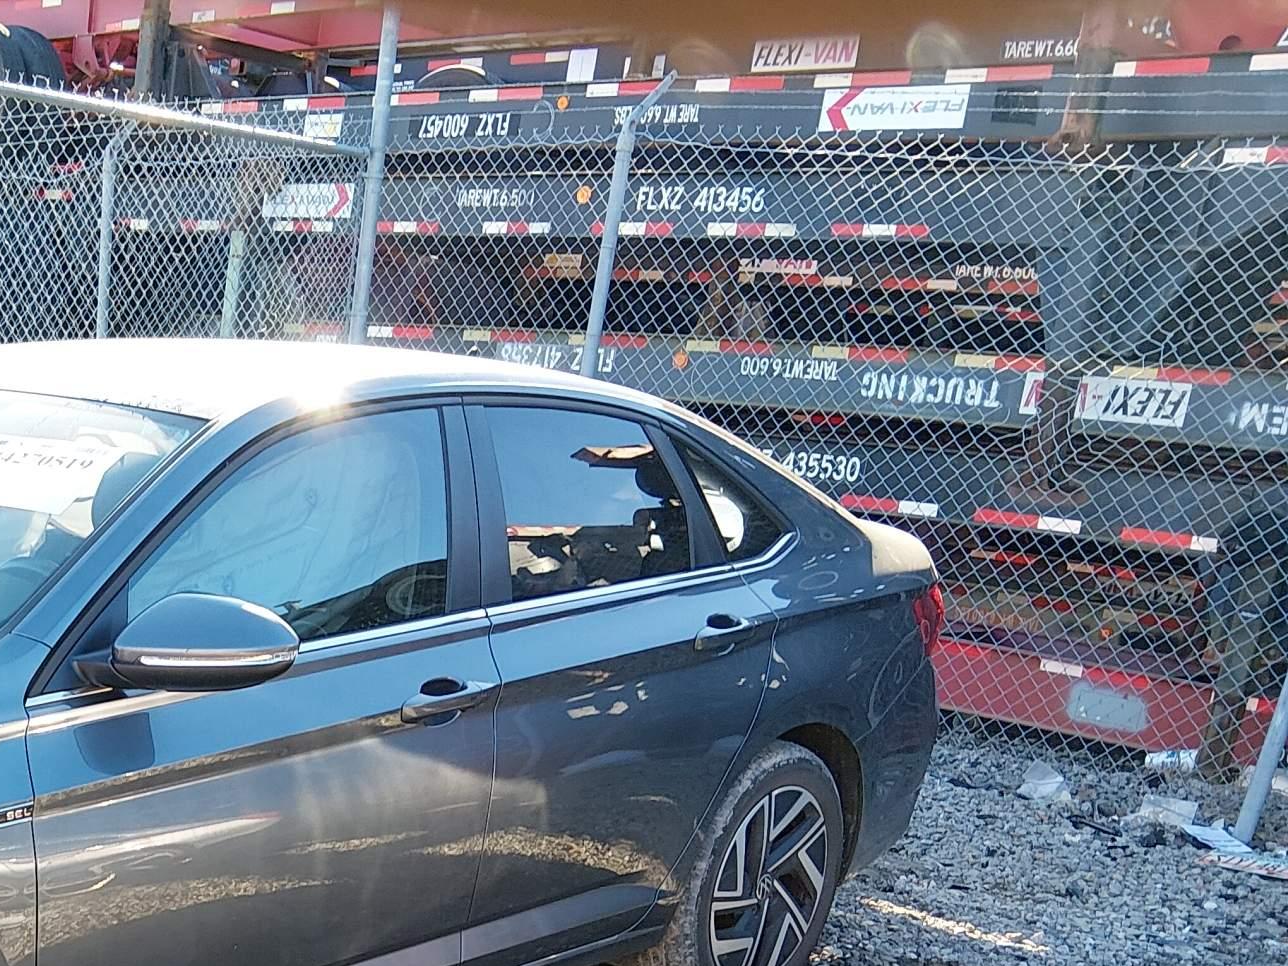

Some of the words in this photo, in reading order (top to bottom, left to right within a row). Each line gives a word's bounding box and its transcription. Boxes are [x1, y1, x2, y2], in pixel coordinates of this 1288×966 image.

[753, 39, 856, 67] FLEXI-VAN
[475, 112, 511, 136] FLXZ
[636, 186, 686, 211] FLXZ
[693, 187, 766, 213] 413456
[860, 371, 1002, 408] TRUCKING
[782, 451, 861, 482] 435530
[6, 807, 32, 821] SEL
